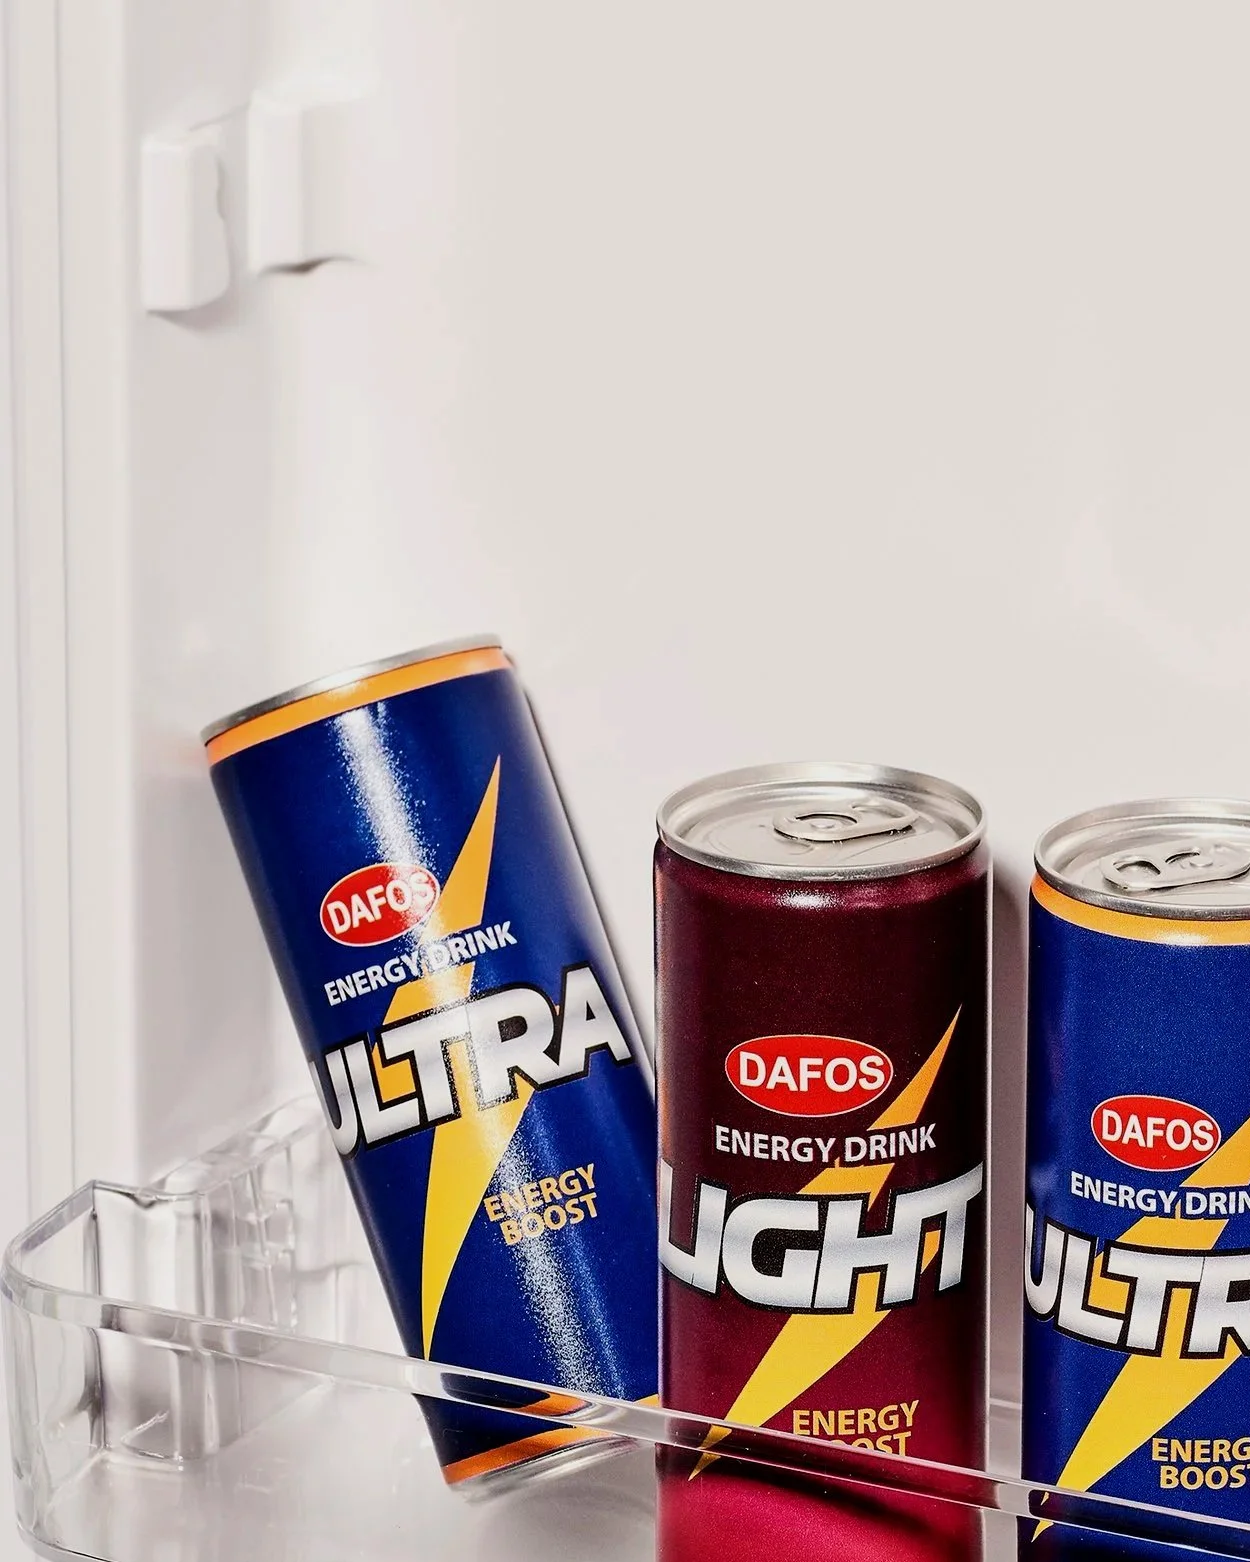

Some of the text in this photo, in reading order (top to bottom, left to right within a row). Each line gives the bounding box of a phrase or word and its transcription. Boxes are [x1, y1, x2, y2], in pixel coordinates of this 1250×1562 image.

[326, 869, 436, 936] DAFOS
[323, 920, 518, 1007] ENERGY DRINK
[308, 966, 632, 1155] ULTRA
[738, 1051, 887, 1093] DAFOS
[714, 1123, 937, 1163] ENERGY DRINK
[1101, 1108, 1217, 1153] DAFOS
[483, 1163, 596, 1223] ENERGY
[499, 1192, 599, 1246] BOOST
[1070, 1170, 1180, 1215] ENERGY
[659, 1158, 984, 1310] LIGHT
[793, 1400, 919, 1436] ENERGY
